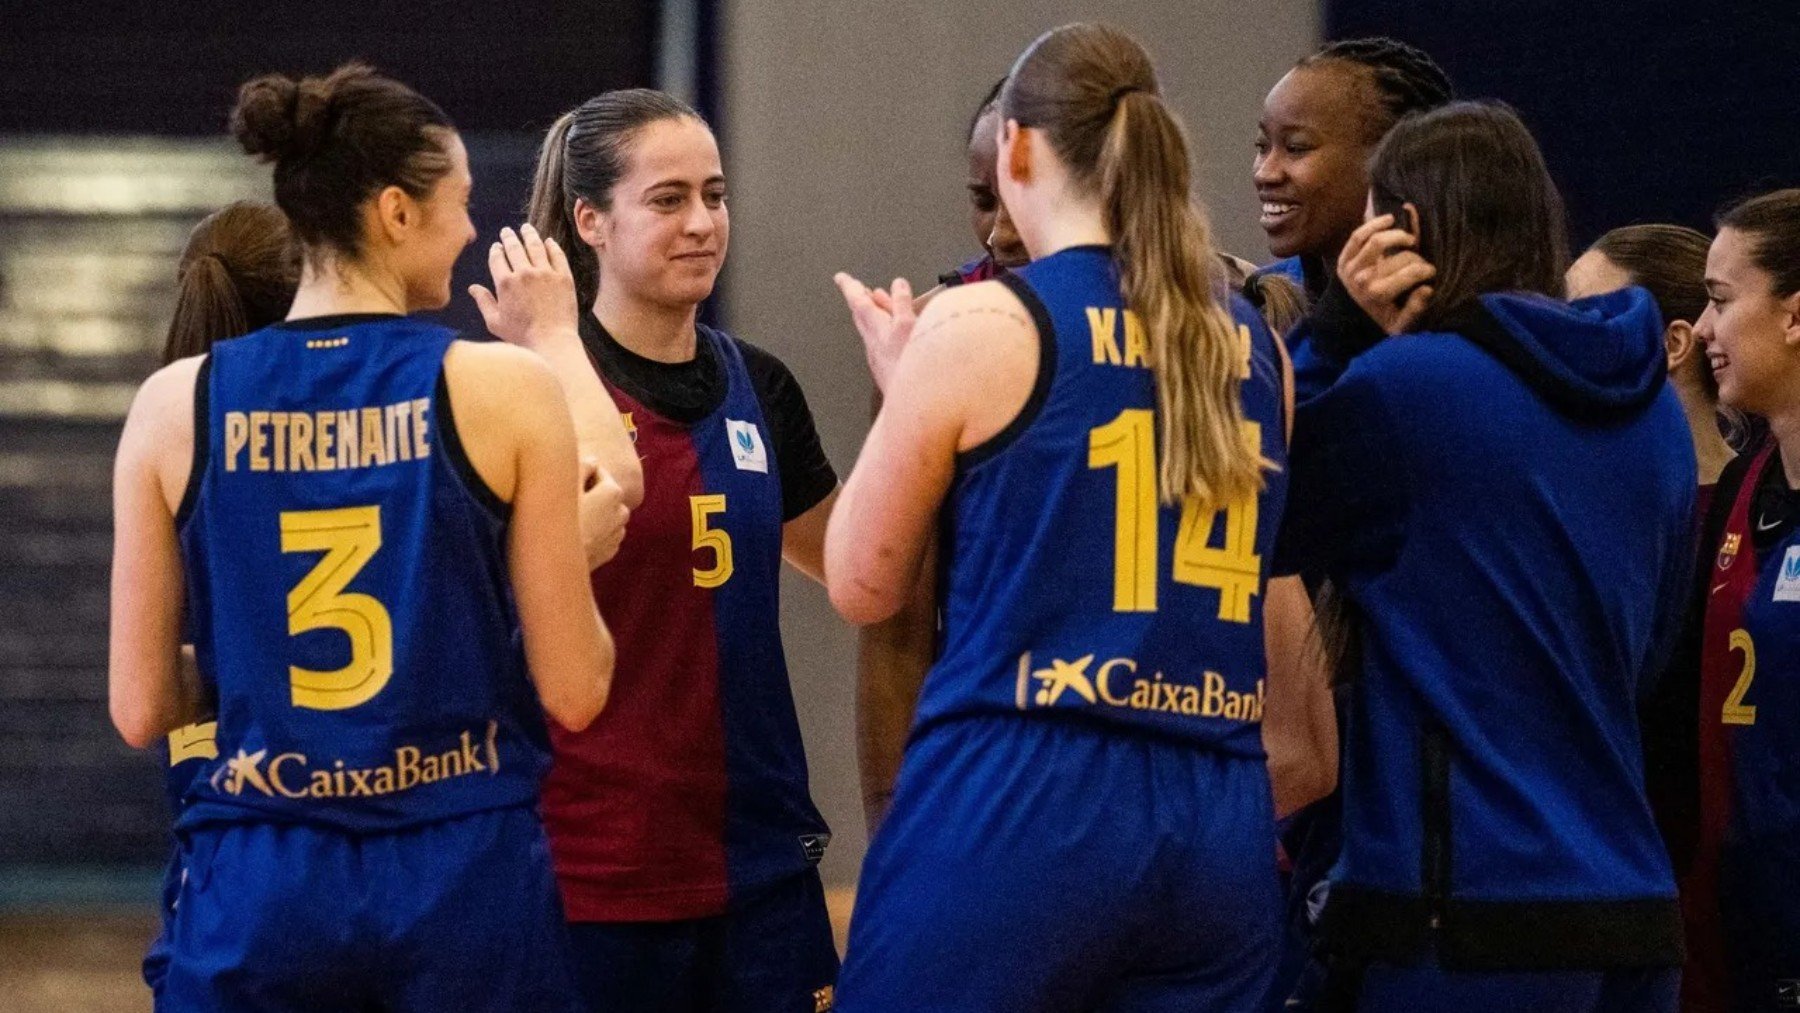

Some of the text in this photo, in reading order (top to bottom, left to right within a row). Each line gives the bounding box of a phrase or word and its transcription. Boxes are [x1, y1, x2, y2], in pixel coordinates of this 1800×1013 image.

[225, 397, 431, 472] PETRENAITE
[689, 494, 734, 588] 5
[1088, 408, 1261, 623] 14
[279, 504, 393, 711] 3
[1721, 628, 1757, 725] 2
[268, 730, 487, 798] CaixaBank
